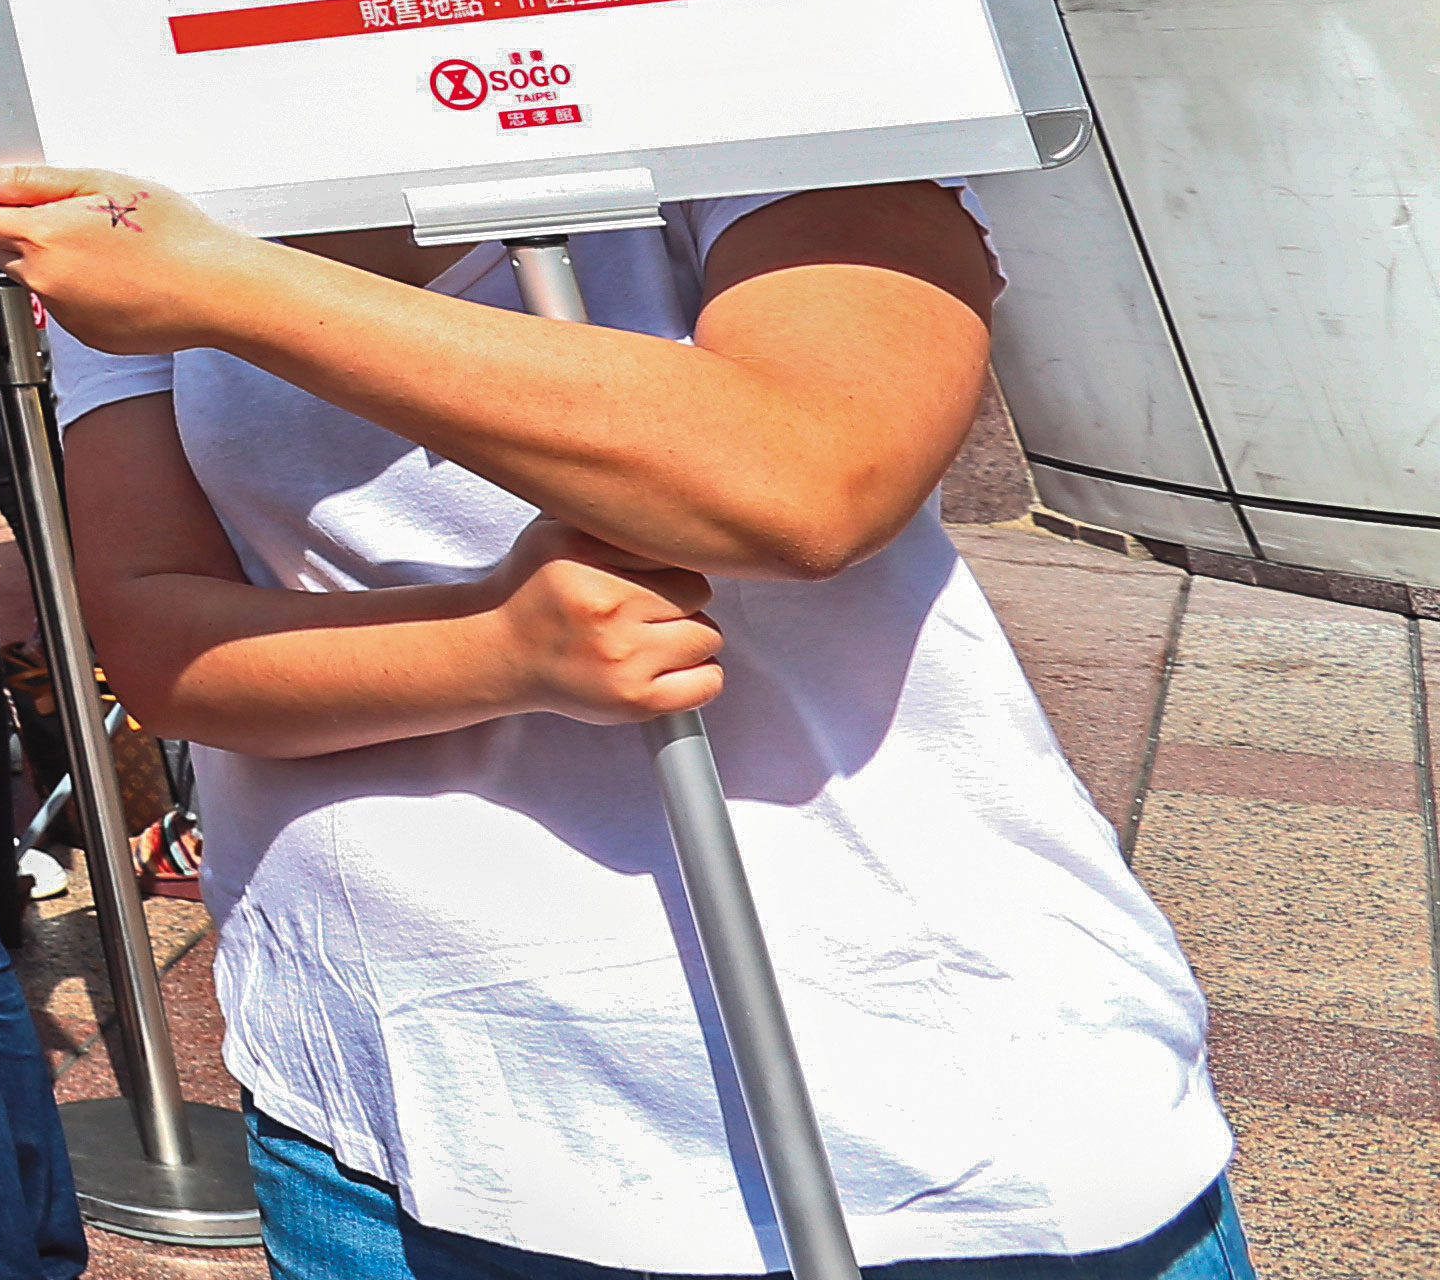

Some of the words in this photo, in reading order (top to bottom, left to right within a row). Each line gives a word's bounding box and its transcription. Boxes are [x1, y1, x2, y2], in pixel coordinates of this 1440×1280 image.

[488, 64, 572, 93] SOGO
[505, 105, 576, 130] 忠孝館
